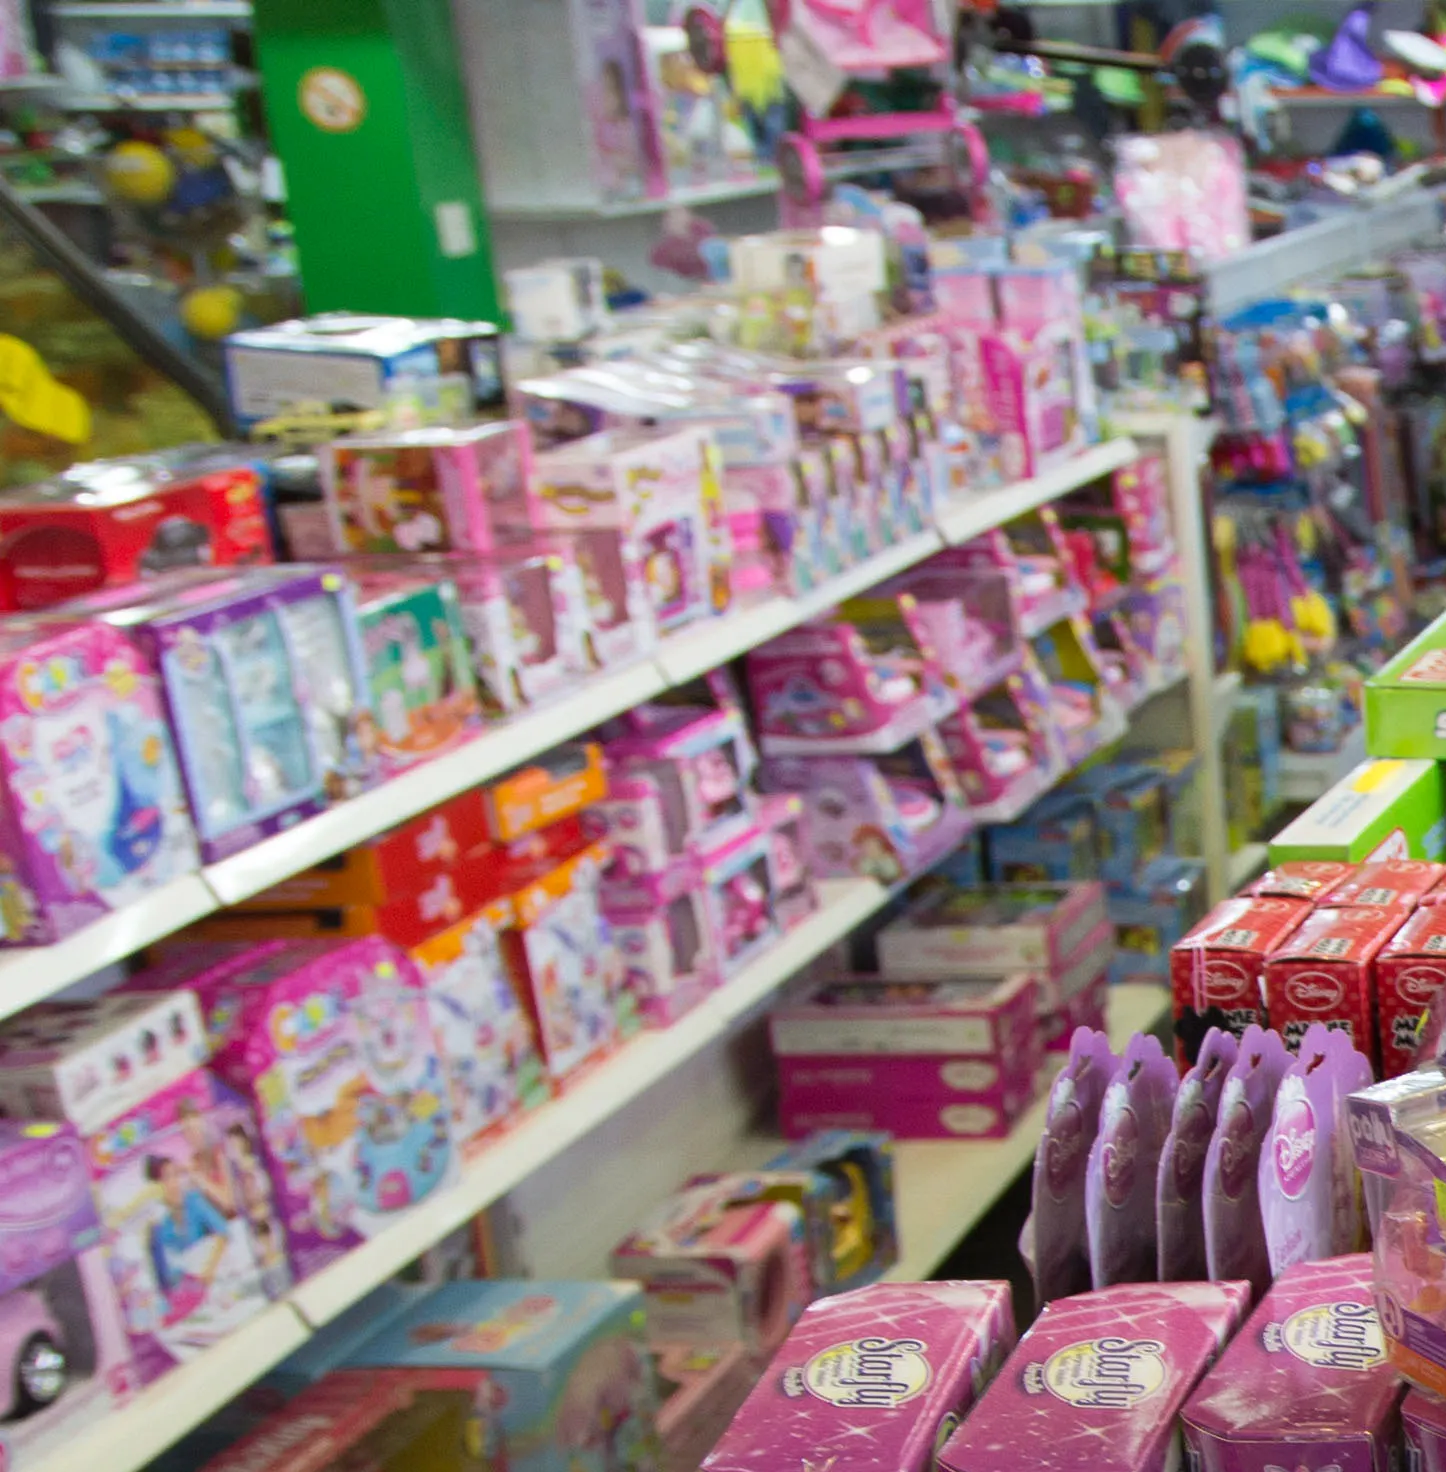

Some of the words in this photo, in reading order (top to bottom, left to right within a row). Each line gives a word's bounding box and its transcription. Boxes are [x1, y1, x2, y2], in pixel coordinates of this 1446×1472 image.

[1313, 1302, 1381, 1371] Starfly
[829, 1337, 926, 1408] Starfly
[1069, 1337, 1165, 1408] Starfly
